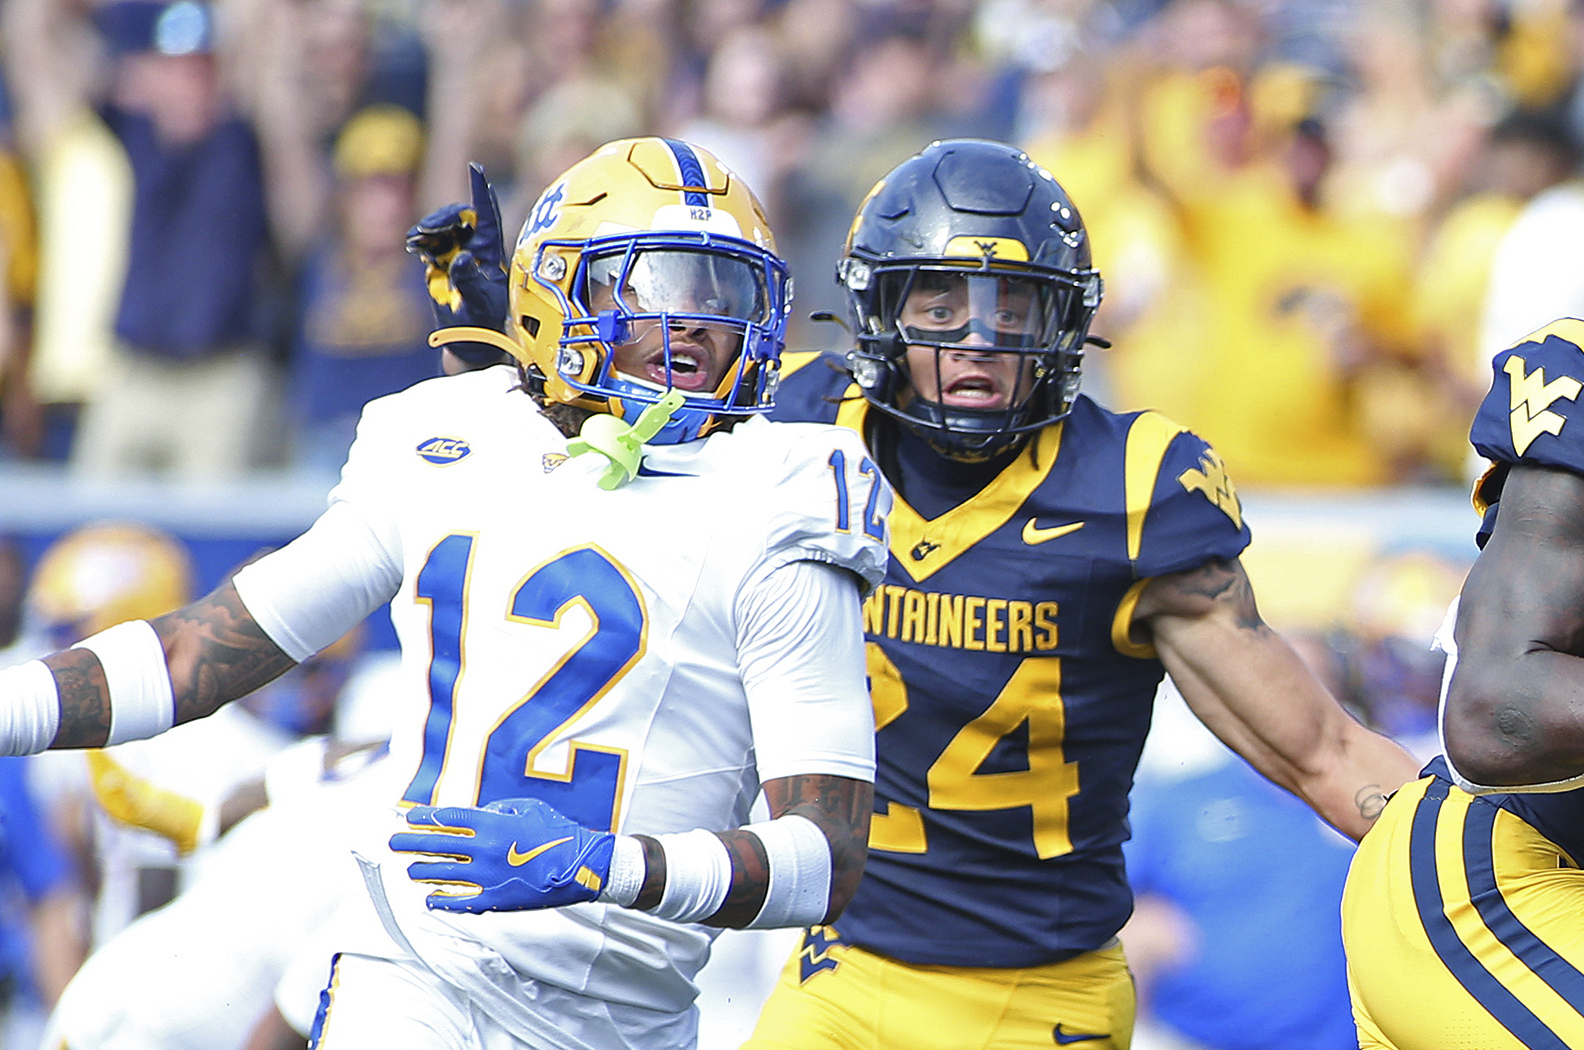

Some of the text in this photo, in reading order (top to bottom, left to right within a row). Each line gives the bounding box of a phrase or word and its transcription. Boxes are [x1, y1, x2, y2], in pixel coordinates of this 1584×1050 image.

[690, 208, 712, 221] H2P
[828, 449, 891, 545] 12
[863, 583, 1060, 653] NTAINEERS
[399, 530, 648, 835] 12
